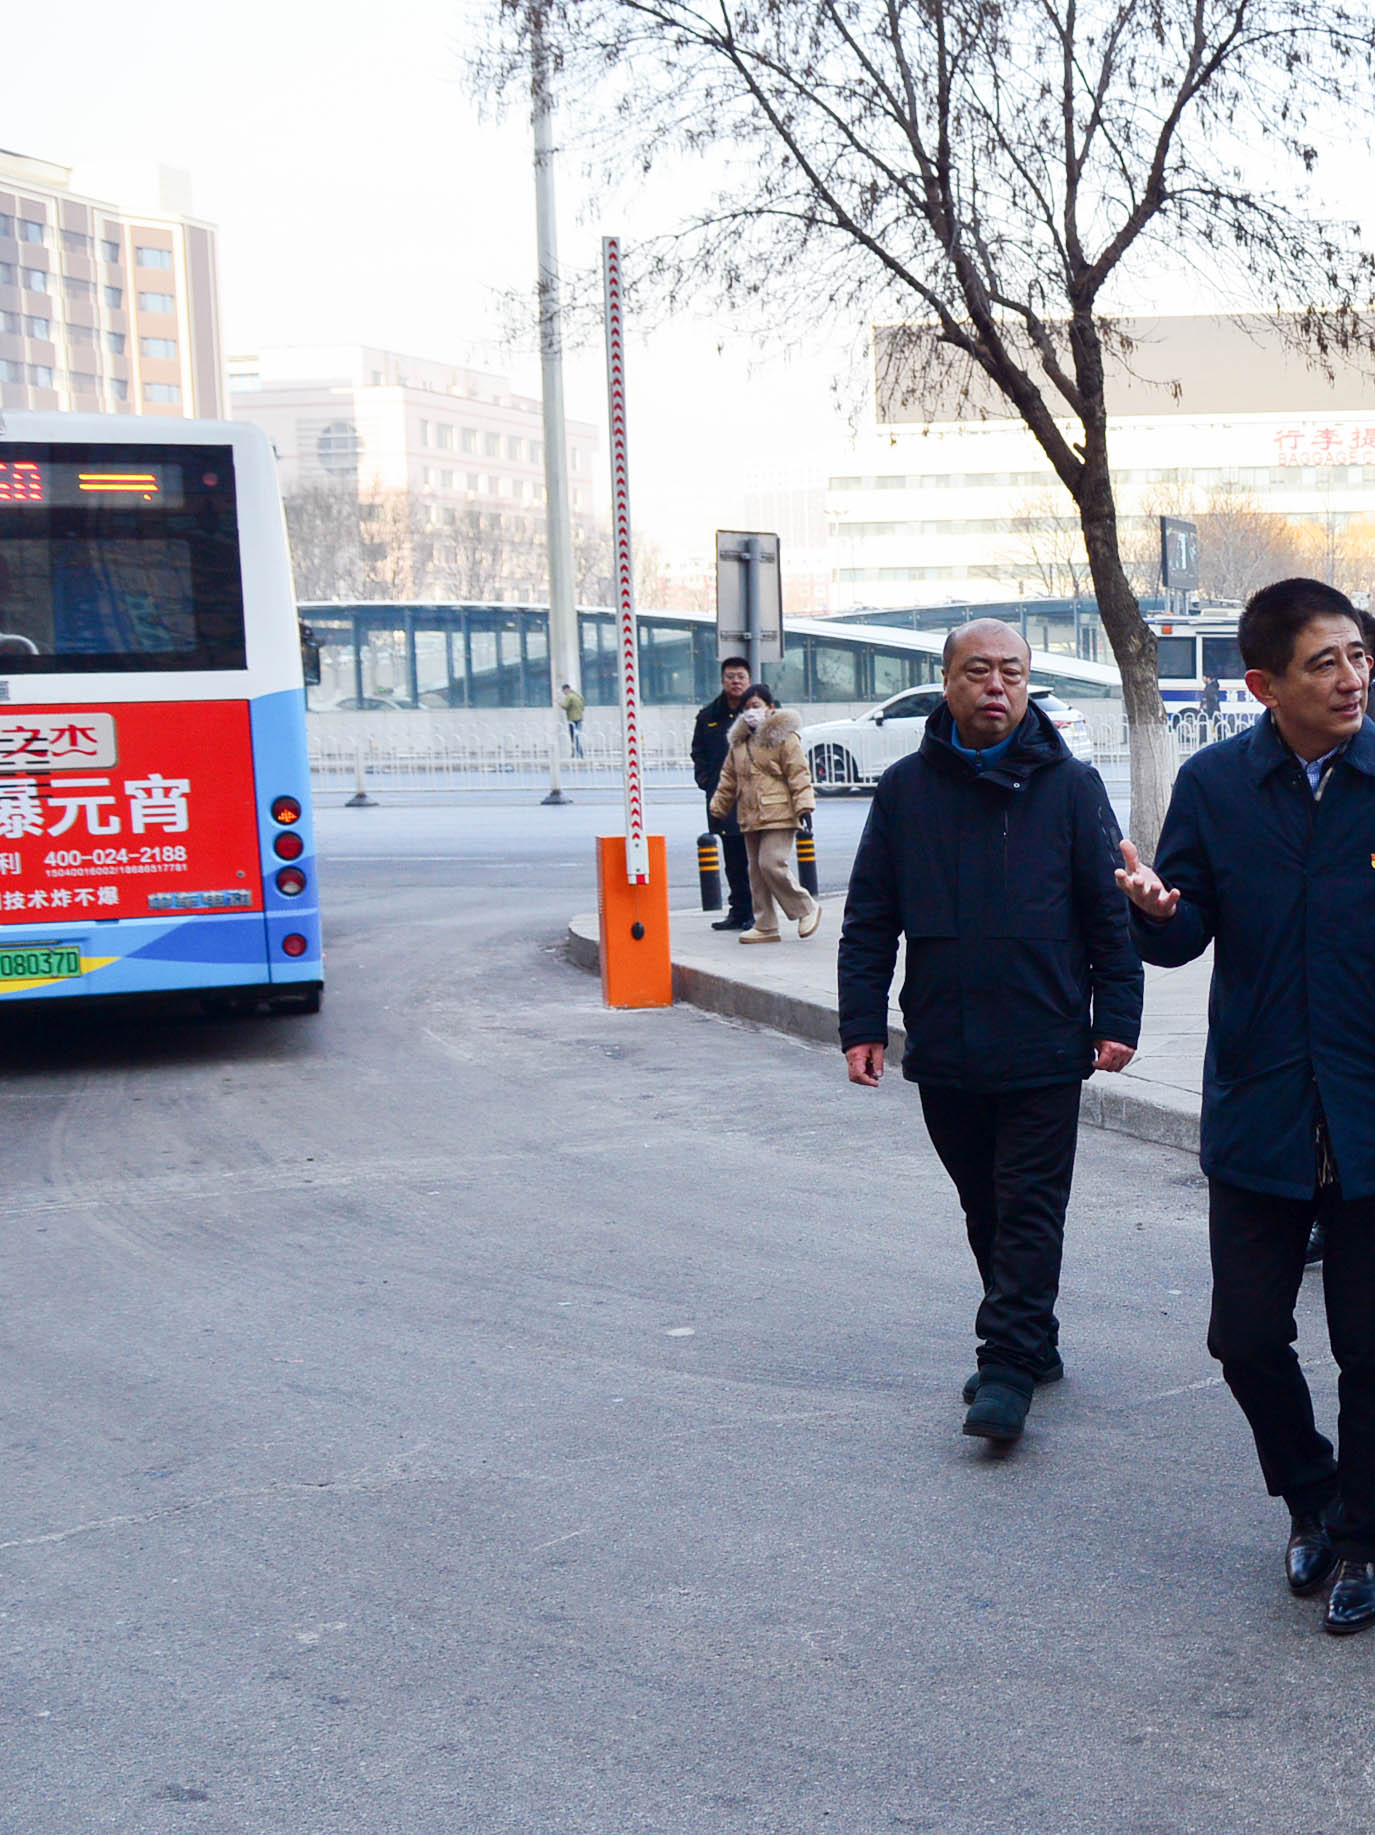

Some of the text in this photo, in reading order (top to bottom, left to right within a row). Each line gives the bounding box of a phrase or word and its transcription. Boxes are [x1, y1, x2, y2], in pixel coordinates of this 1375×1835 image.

[1277, 452, 1357, 466] BAGGAGE
[0, 852, 22, 875] 利
[43, 845, 188, 867] 400-024-2188
[0, 886, 120, 911] 技术炸不爆
[1, 951, 79, 976] 08037D
